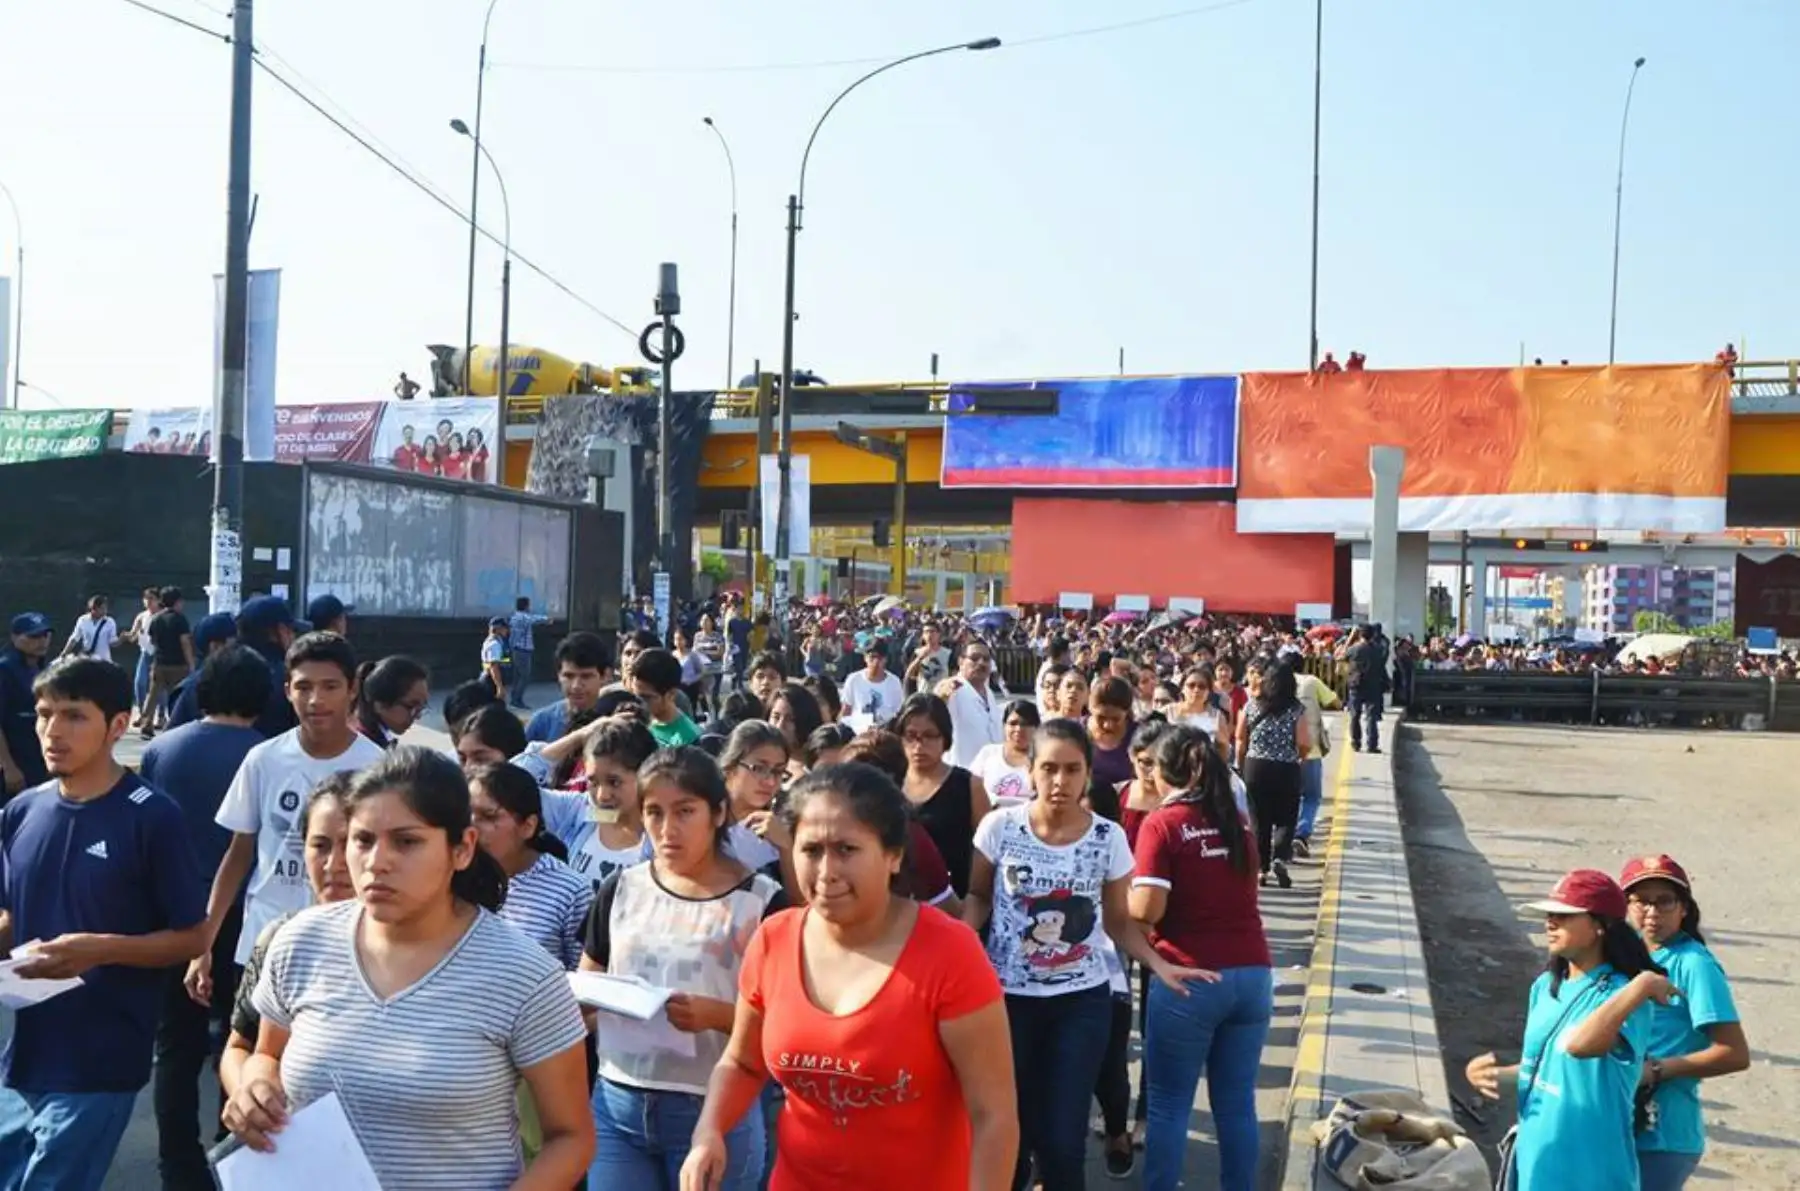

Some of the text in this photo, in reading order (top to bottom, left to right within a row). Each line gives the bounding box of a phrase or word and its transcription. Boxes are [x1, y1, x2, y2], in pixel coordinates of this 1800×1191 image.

[289, 442, 305, 453] DE
[306, 441, 339, 452] ABRIL
[778, 1052, 861, 1074] SIMPLY
